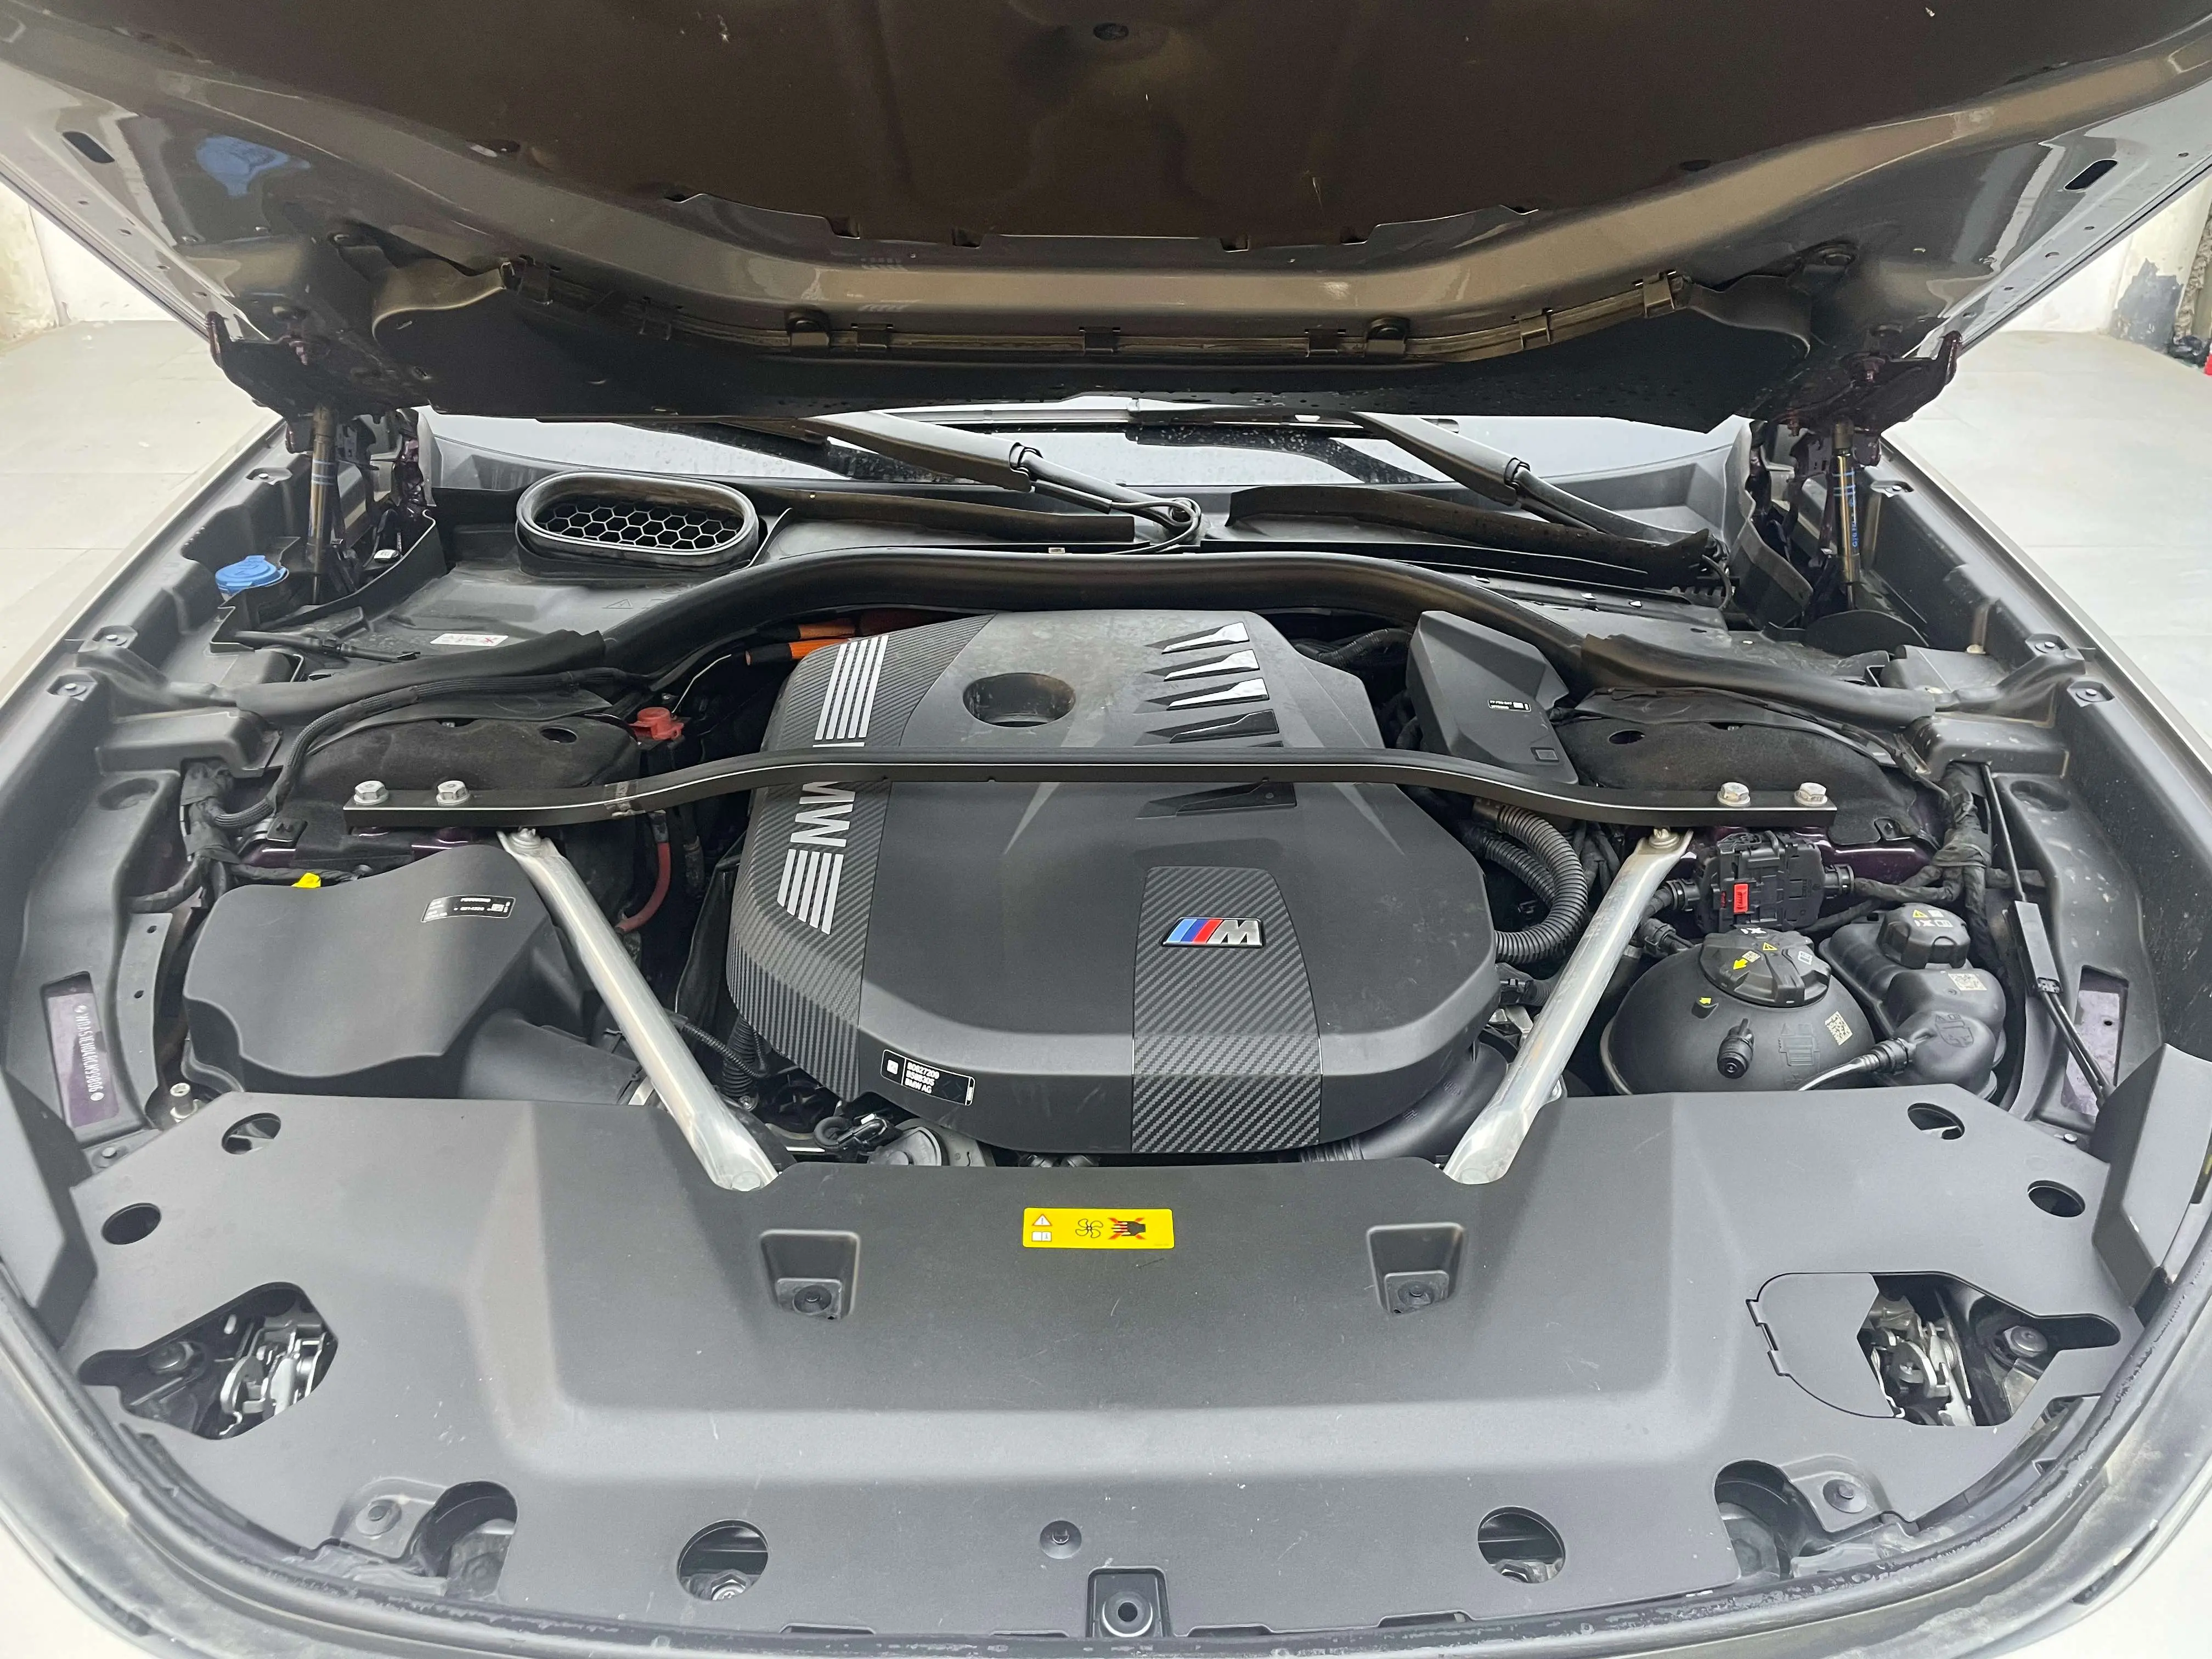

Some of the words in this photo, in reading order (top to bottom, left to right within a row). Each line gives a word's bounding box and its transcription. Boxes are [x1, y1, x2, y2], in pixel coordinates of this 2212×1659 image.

[1207, 919, 1260, 946] M
[905, 1077, 922, 1090] BMW
[922, 1084, 932, 1093] AG
